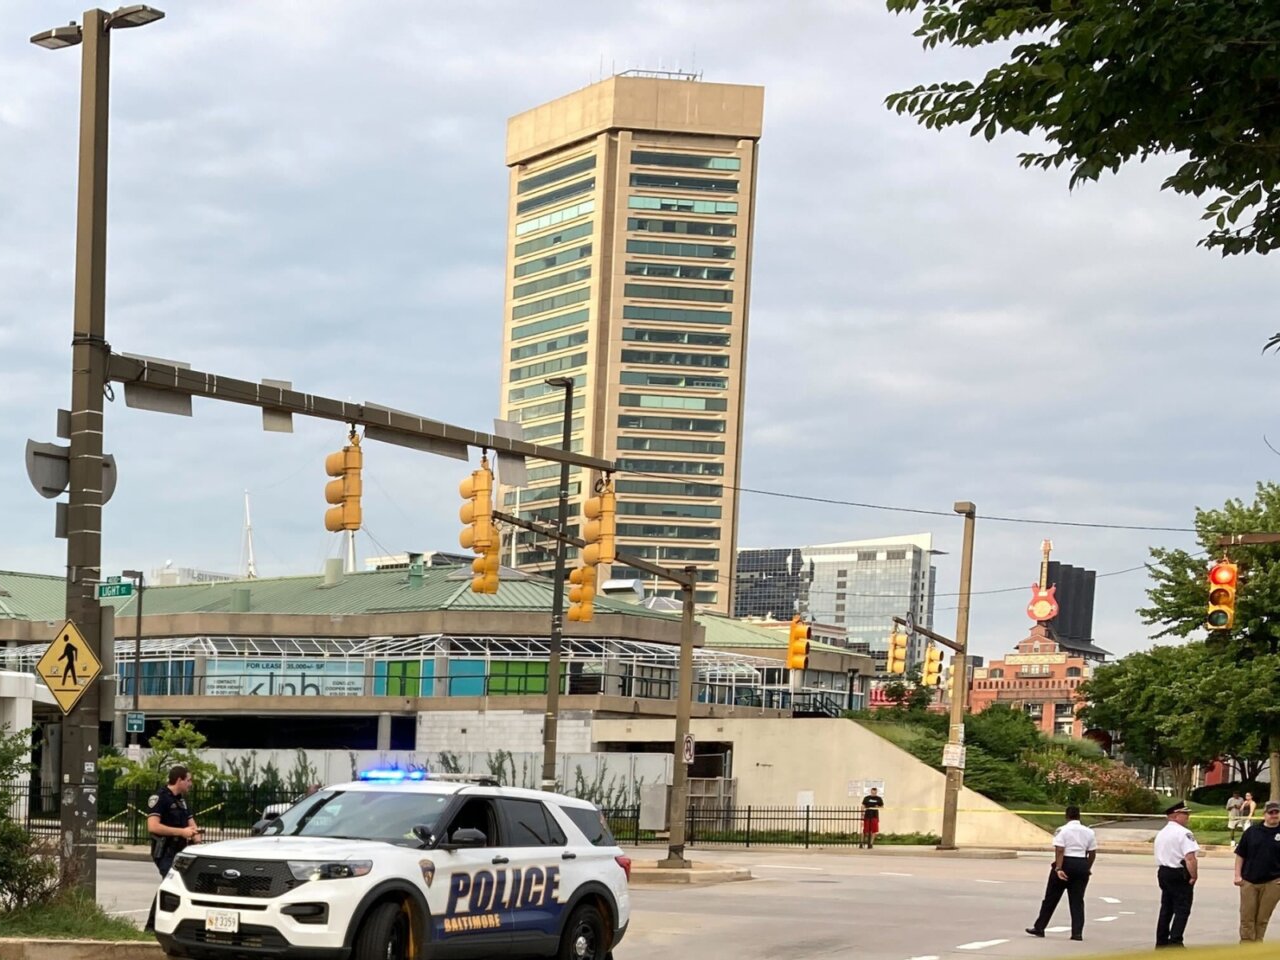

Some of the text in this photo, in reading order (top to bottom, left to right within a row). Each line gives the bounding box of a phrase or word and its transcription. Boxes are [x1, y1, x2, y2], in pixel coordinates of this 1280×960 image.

[101, 586, 120, 597] LIGHT
[445, 863, 562, 916] POLICE
[444, 913, 501, 932] BALTIMORE
